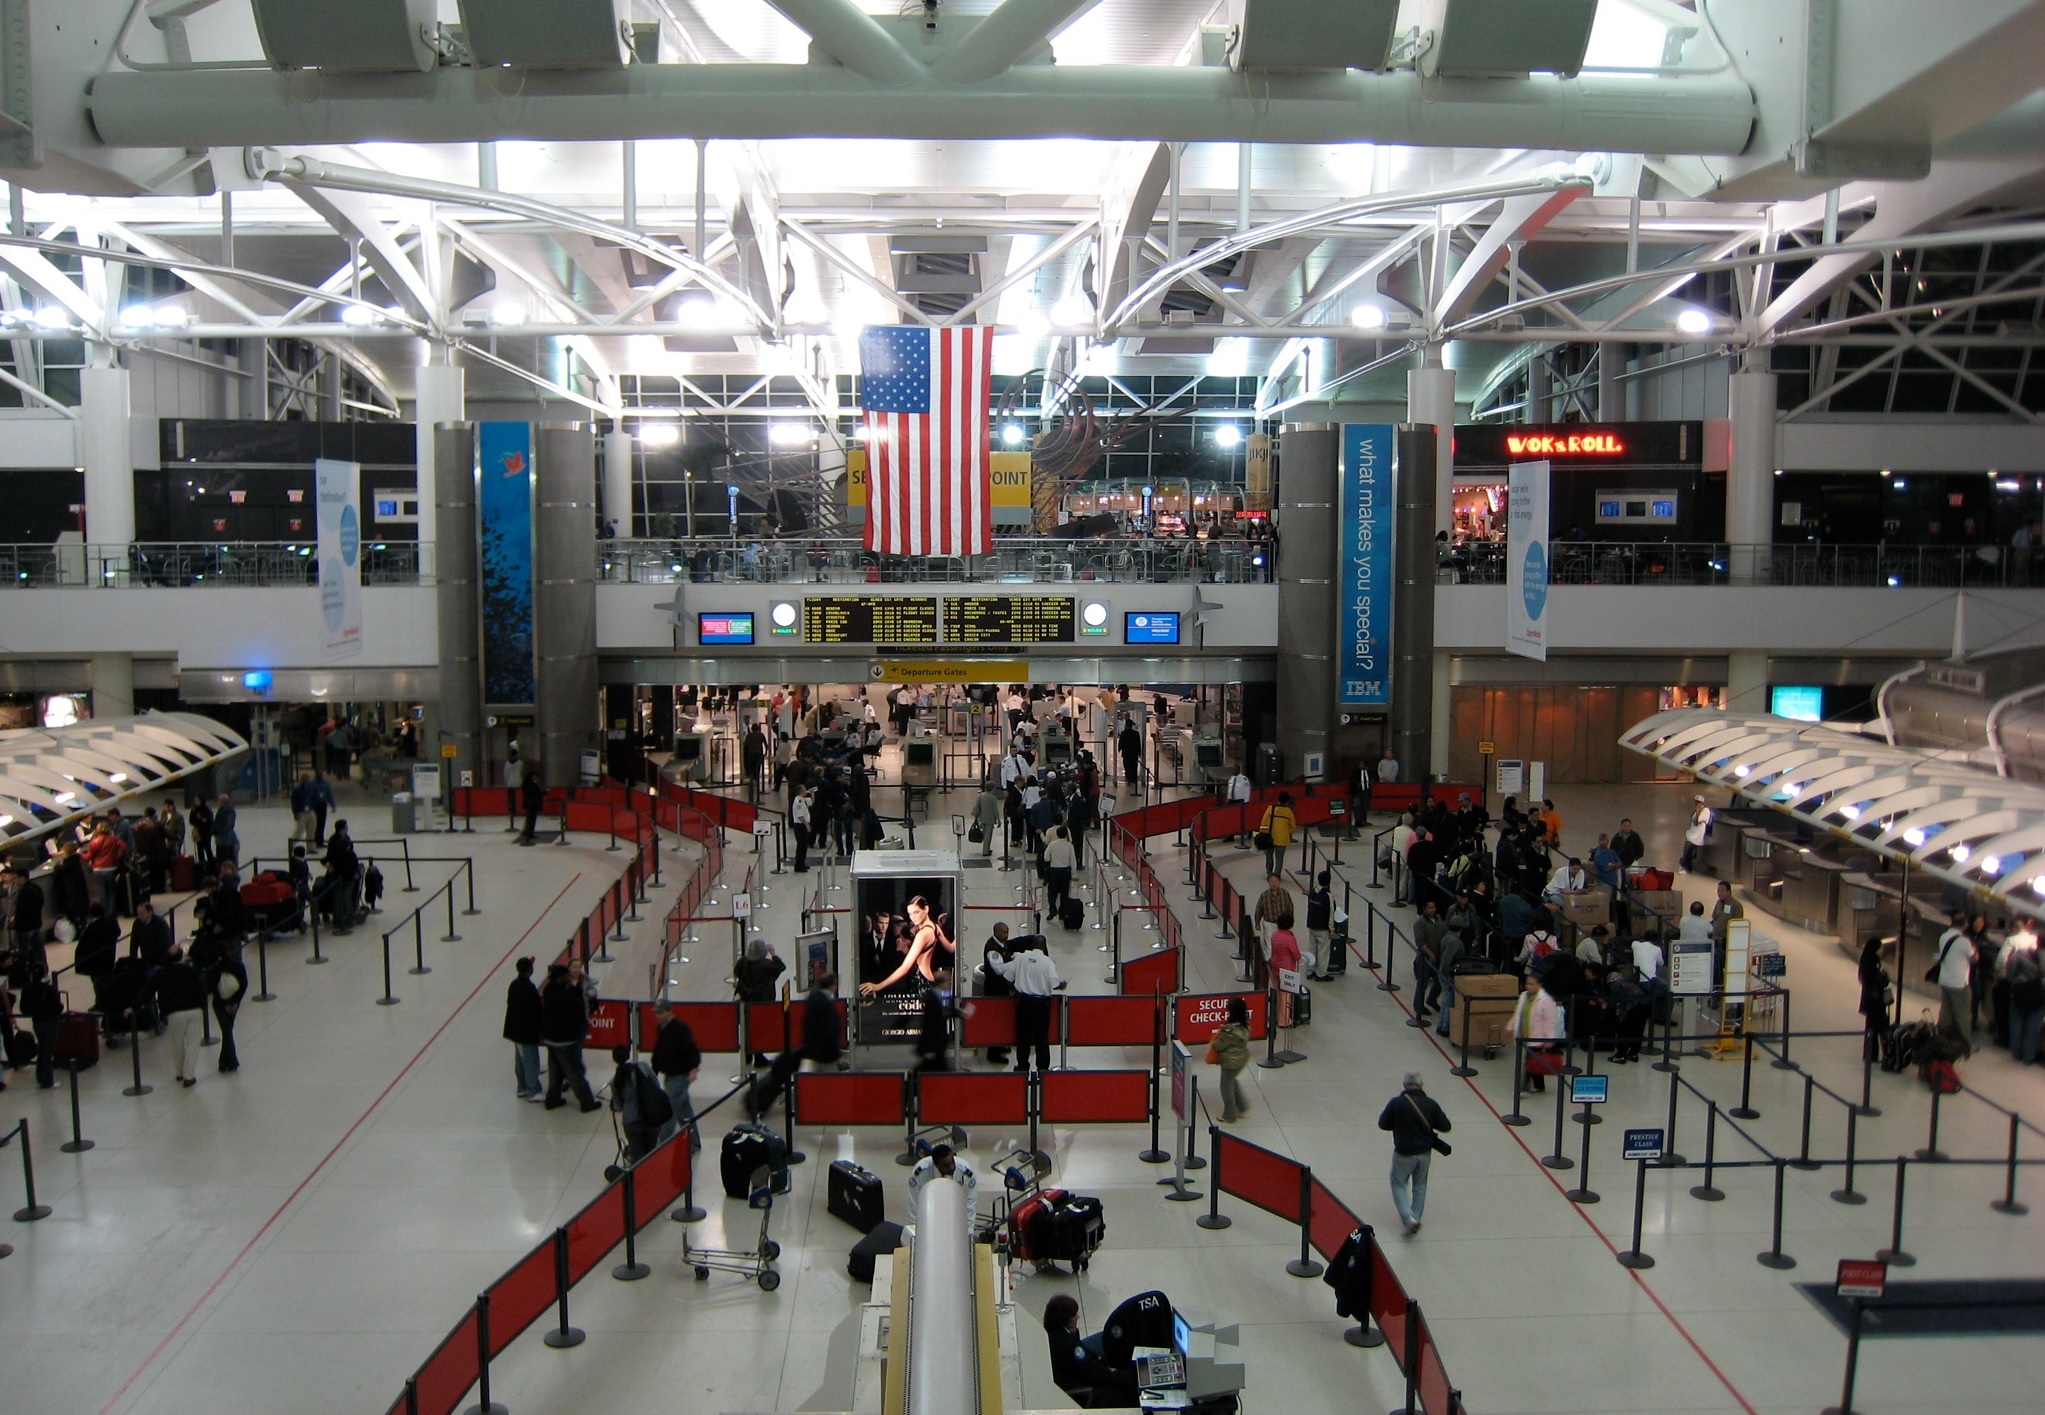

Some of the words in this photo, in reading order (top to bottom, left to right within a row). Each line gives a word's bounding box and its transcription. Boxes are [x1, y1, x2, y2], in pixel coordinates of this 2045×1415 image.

[1359, 439, 1377, 484] what
[1358, 490, 1376, 552] makes
[1353, 556, 1371, 590] you
[1353, 595, 1374, 670] special?
[901, 669, 942, 677] Departure
[1346, 680, 1381, 696] IBM
[898, 1000, 926, 1010] code
[1138, 1296, 1160, 1311] TSA
